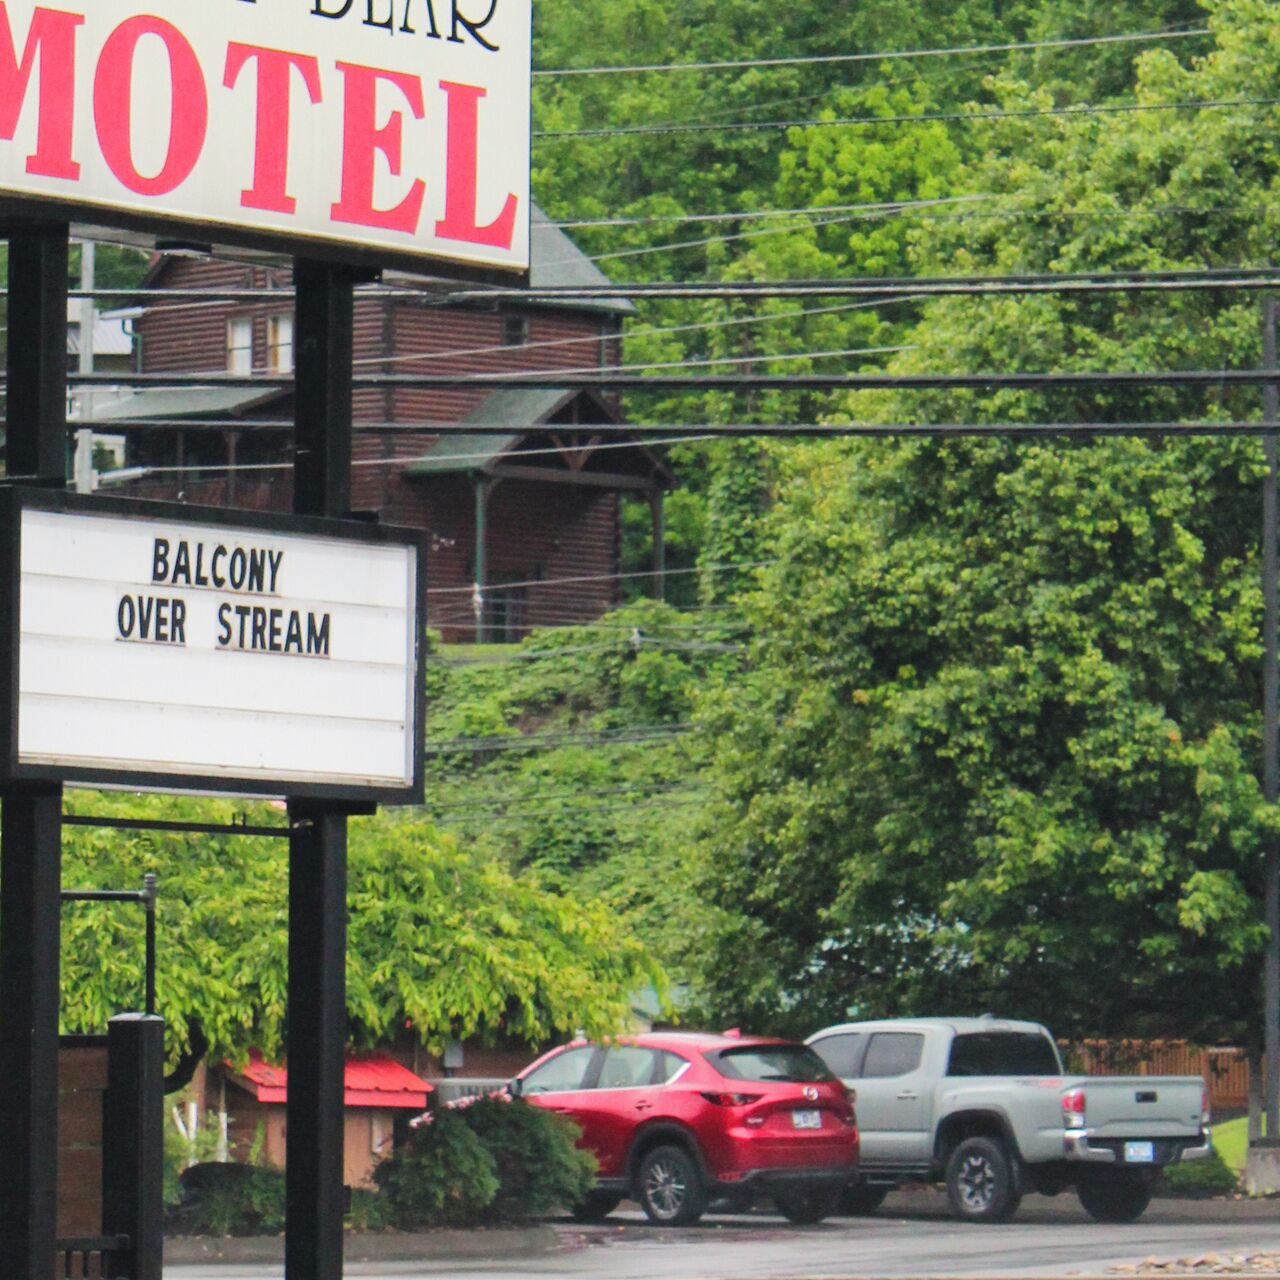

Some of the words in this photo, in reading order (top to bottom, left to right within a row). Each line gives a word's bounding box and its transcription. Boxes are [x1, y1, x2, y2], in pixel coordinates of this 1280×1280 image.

[152, 538, 283, 593] BALCONY
[118, 594, 186, 643] OVER
[218, 602, 331, 655] STREAM
